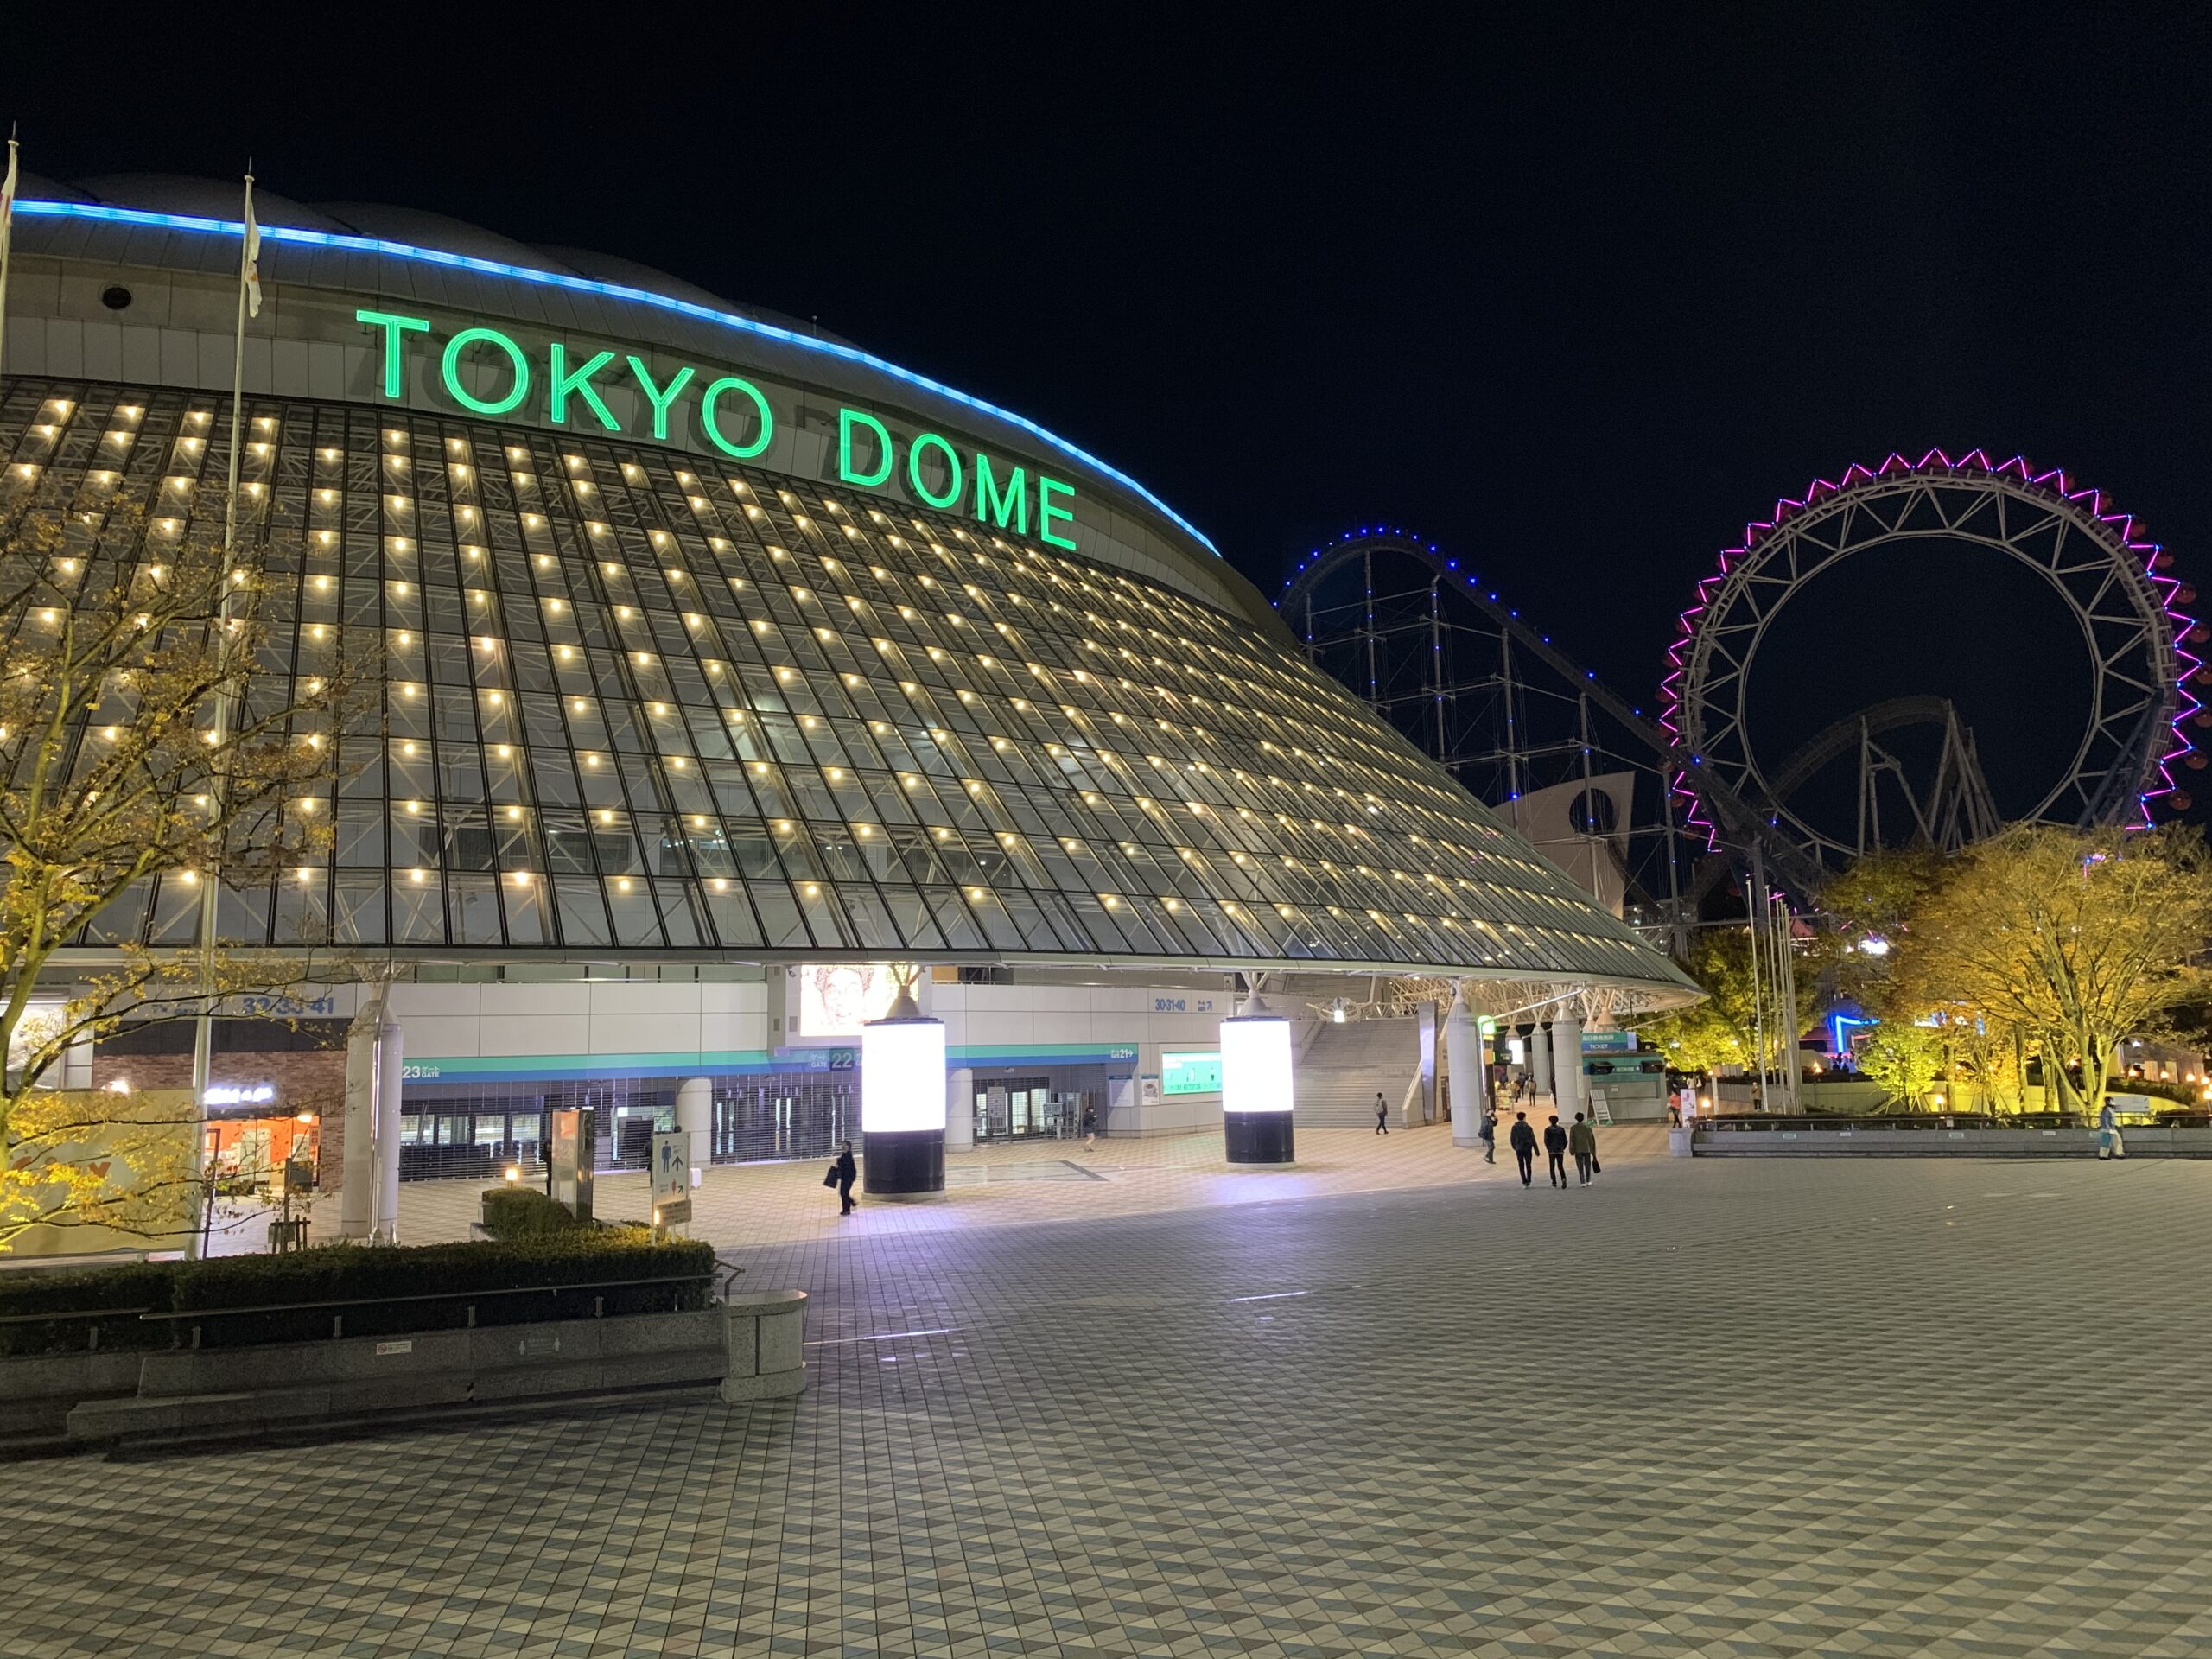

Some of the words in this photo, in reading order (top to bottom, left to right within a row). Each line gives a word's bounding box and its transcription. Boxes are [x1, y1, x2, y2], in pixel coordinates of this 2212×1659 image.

[356, 309, 773, 458] TOKYO
[839, 408, 1077, 551] DOME
[831, 1052, 853, 1070] 22
[403, 1065, 421, 1079] 23
